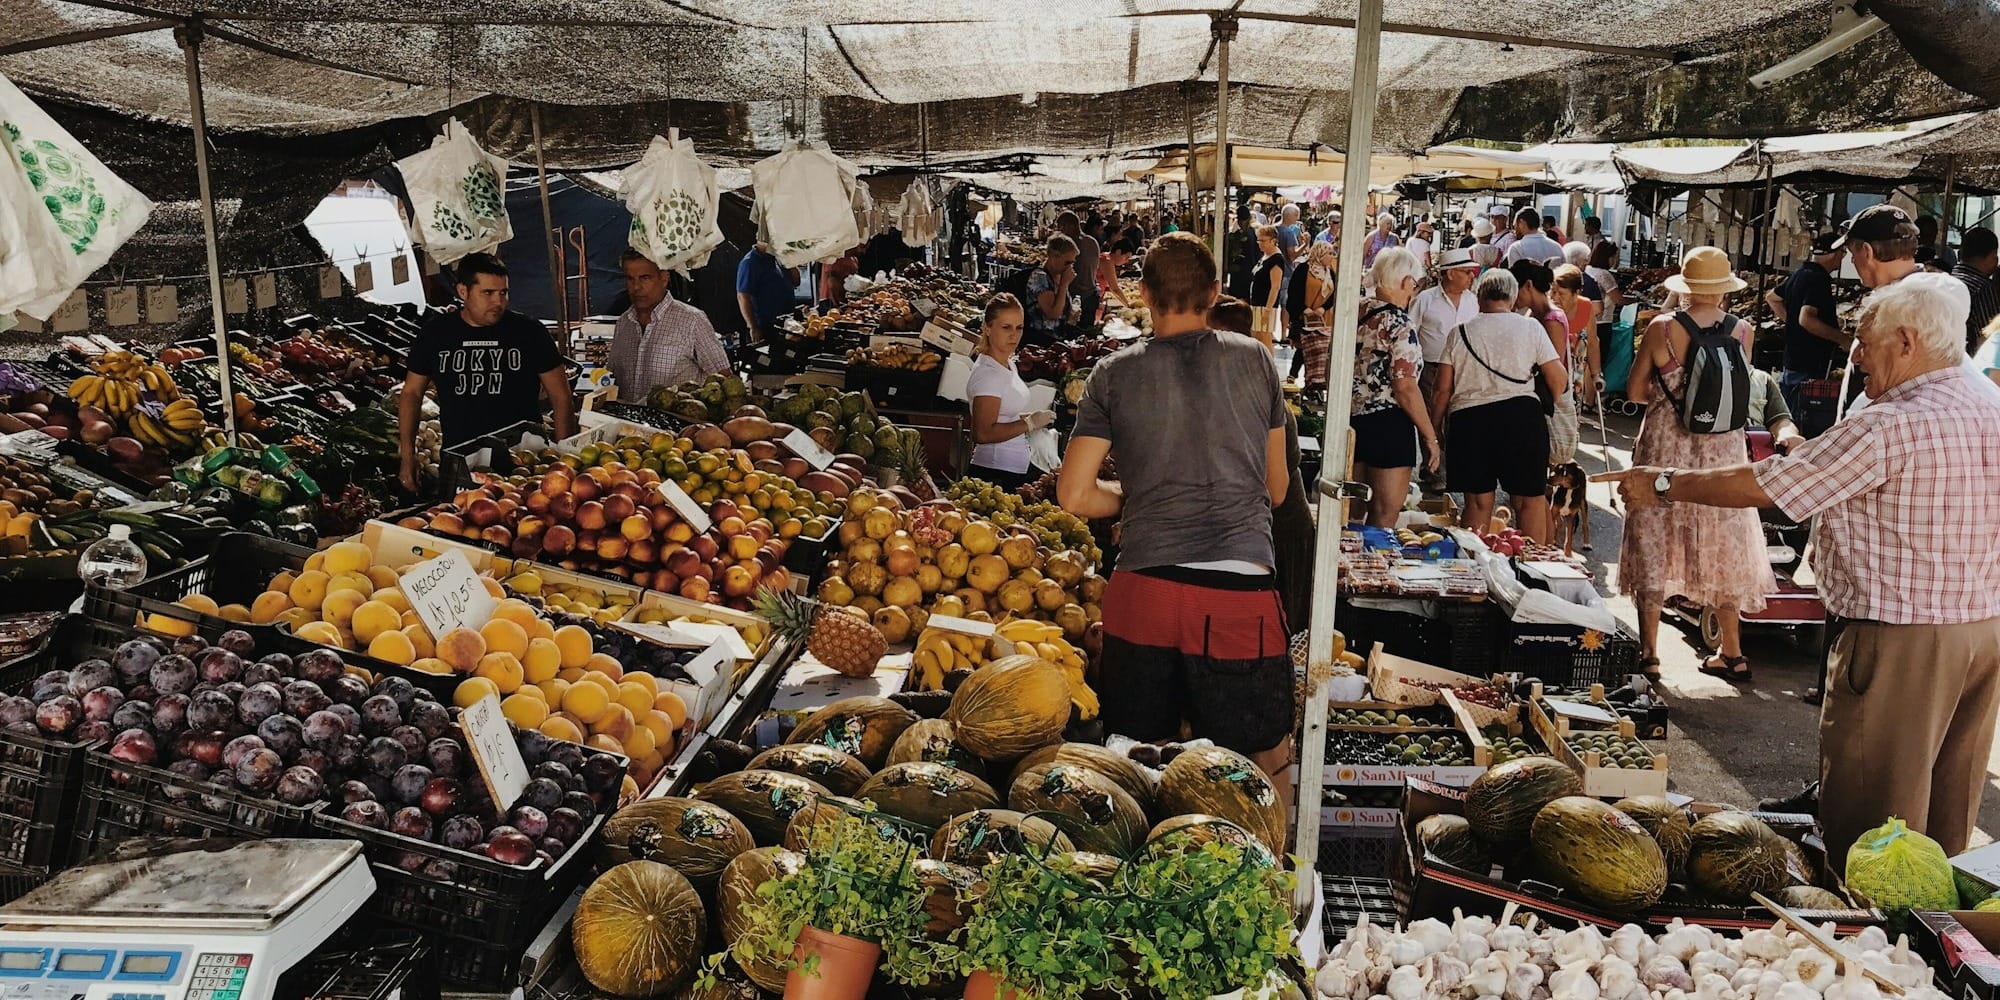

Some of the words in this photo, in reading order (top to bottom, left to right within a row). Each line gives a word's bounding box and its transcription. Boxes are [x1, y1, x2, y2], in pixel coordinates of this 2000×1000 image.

[438, 348, 521, 373] TOKYO
[455, 373, 502, 395] JPN
[1361, 770, 1386, 781] San
[1388, 770, 1435, 781] Miuel
[1359, 811, 1384, 823] San
[204, 955, 210, 963] 7
[216, 956, 222, 964] 8
[229, 955, 235, 964] 9
[212, 967, 219, 975] 5
[224, 967, 231, 975] 6
[197, 978, 202, 986] 1
[208, 979, 214, 987] 2
[220, 979, 227, 987] 3
[191, 990, 198, 998] 0
